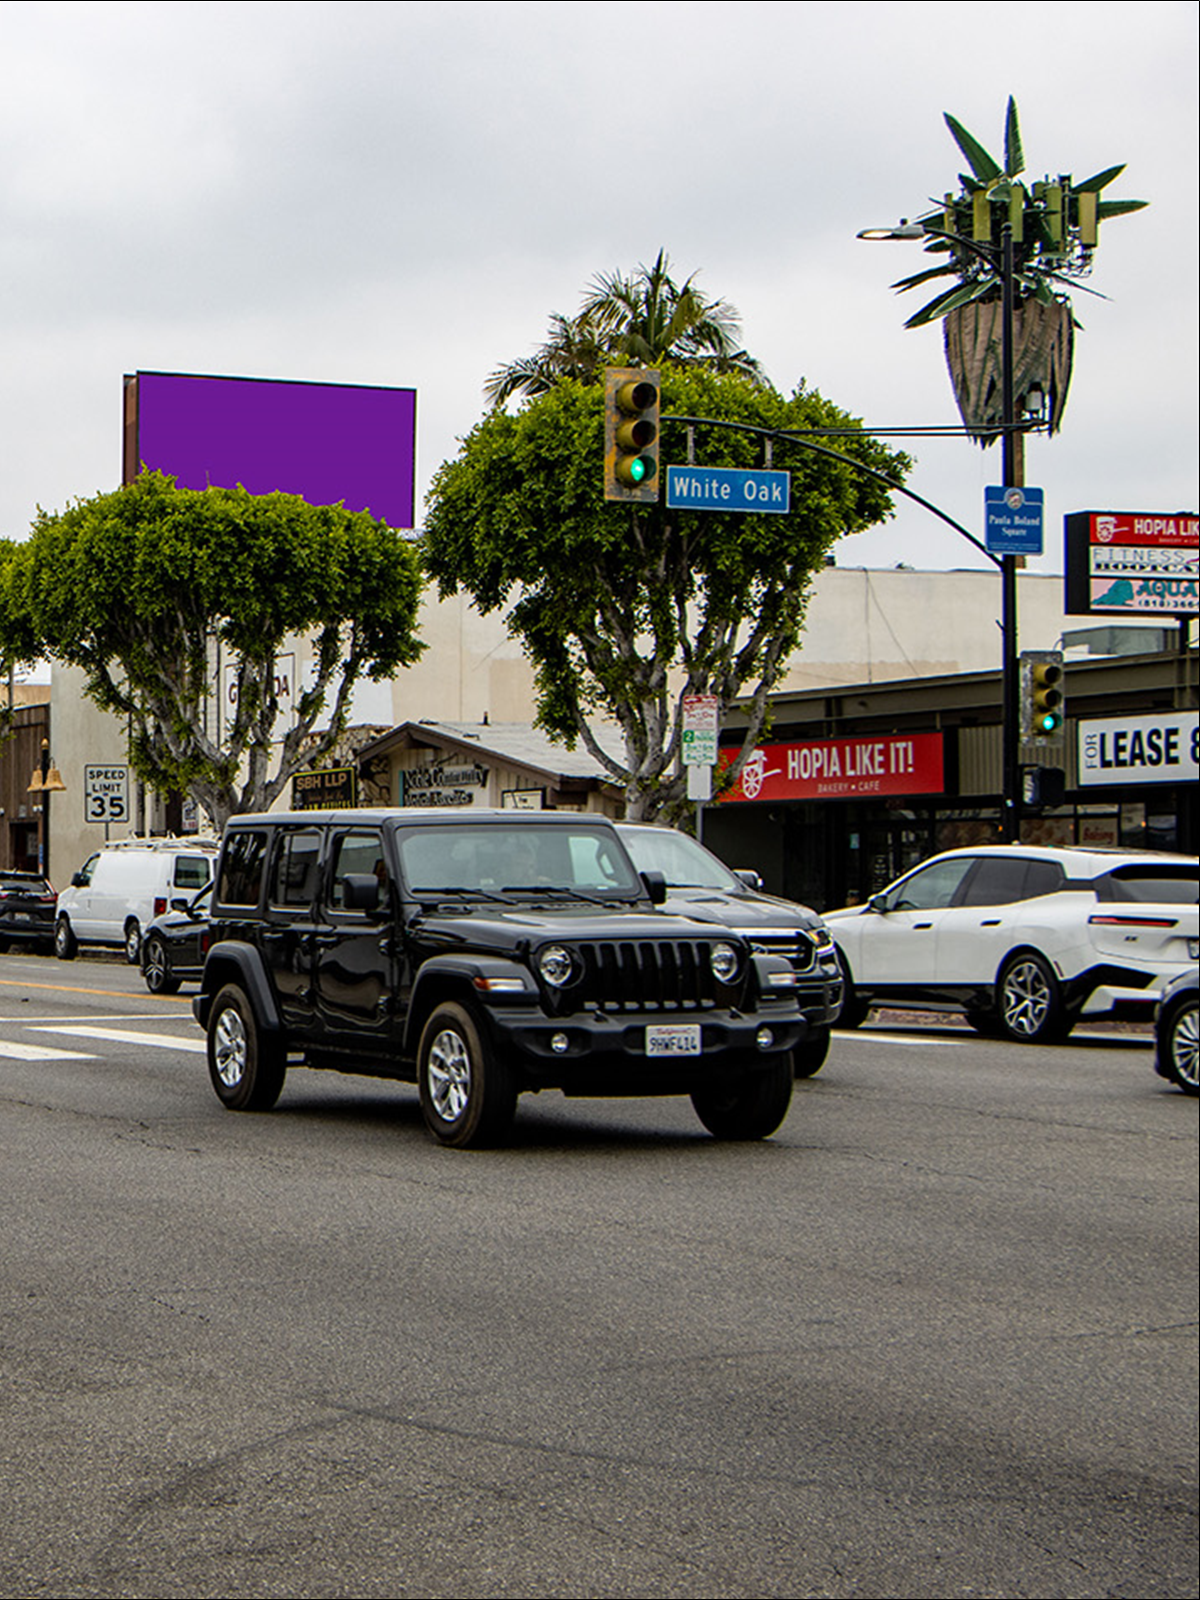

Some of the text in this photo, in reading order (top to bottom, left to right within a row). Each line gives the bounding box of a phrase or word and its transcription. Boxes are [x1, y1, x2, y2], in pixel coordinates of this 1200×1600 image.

[674, 477, 782, 502] White Oak
[989, 514, 1040, 526] Paula Boland
[1133, 518, 1177, 536] HOPIA
[1001, 527, 1027, 537] Square
[1093, 547, 1186, 564] FITNESS
[1093, 561, 1199, 574] BOOTCA
[1135, 580, 1199, 599] AQUA
[1085, 733, 1098, 769] FOR
[1099, 726, 1180, 769] LEASE
[787, 741, 915, 780] HOPIA LIKE IT!
[88, 769, 126, 780] SPEED
[296, 772, 348, 790] SBH LLP
[92, 783, 121, 793] LIMIT
[817, 782, 849, 793] BAKERY
[91, 796, 125, 818] 35
